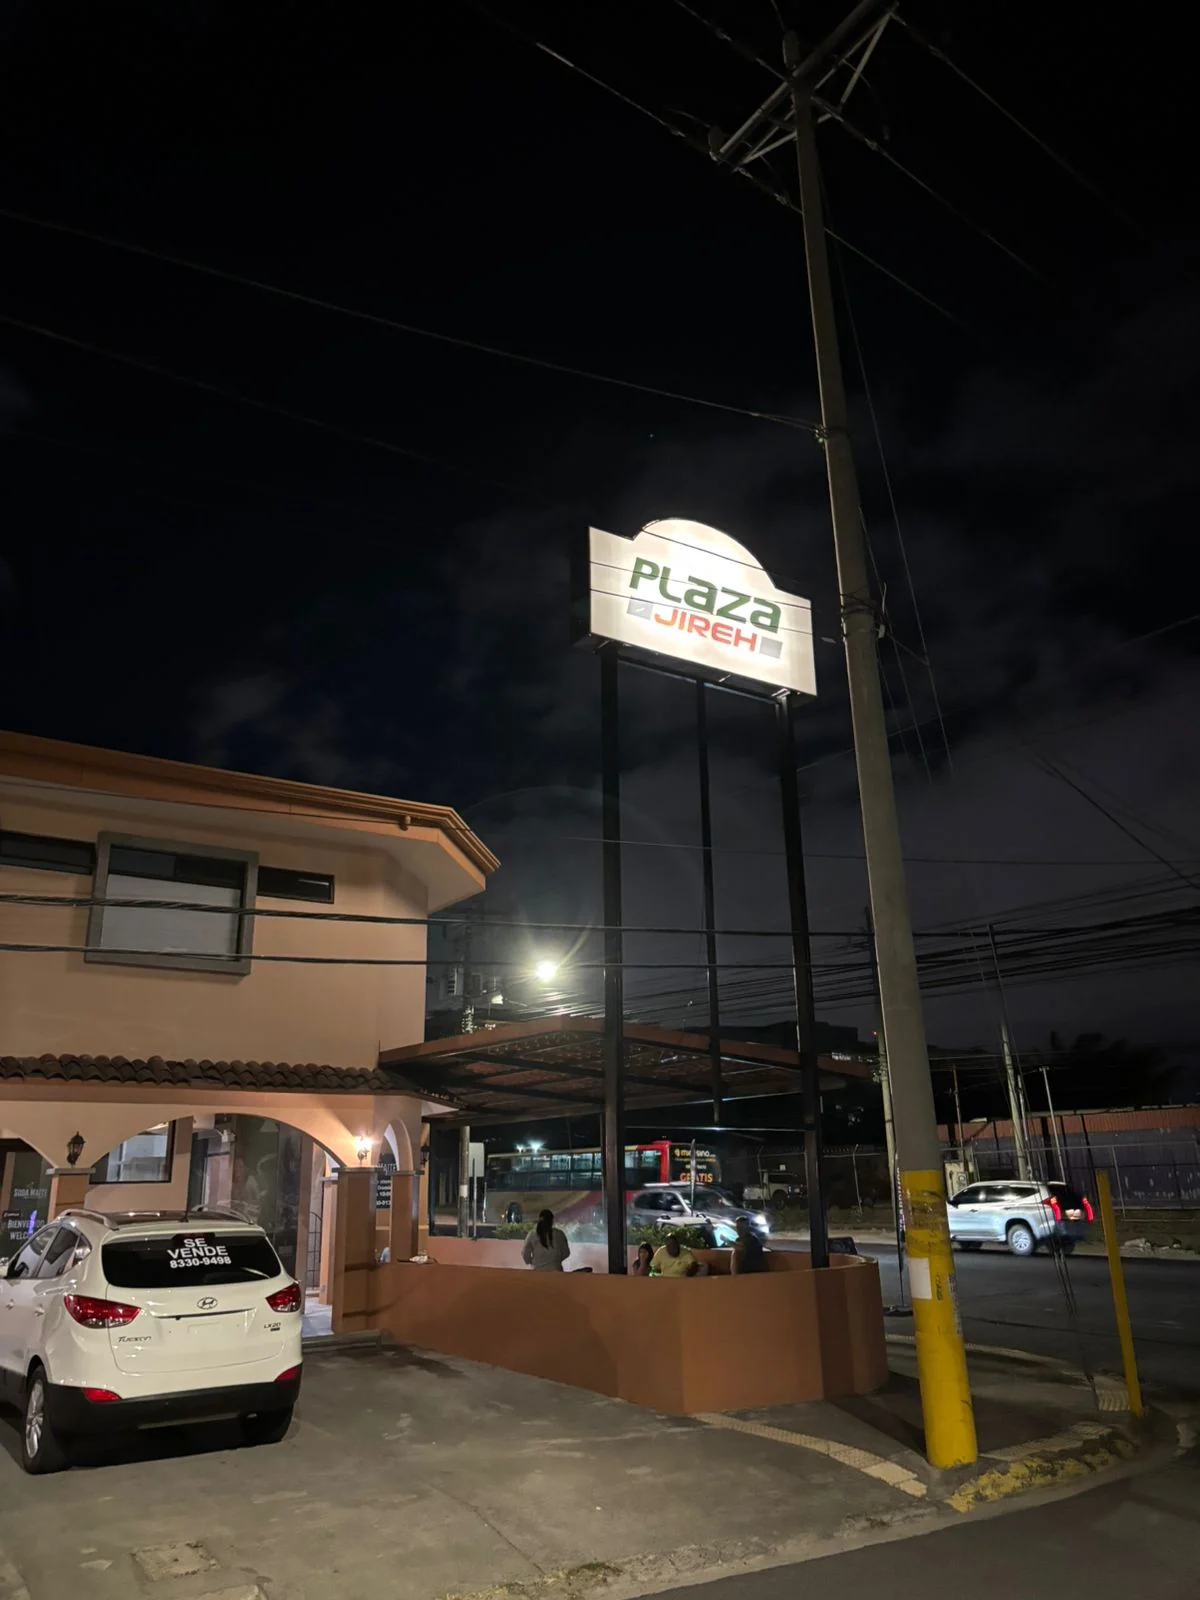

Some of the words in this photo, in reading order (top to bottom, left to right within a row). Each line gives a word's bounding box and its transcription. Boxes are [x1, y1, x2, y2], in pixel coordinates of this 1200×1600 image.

[654, 608, 758, 652] JIREH
[183, 1238, 207, 1248] SE
[167, 1246, 228, 1259] VENDE
[170, 1256, 231, 1268] 8330-9498
